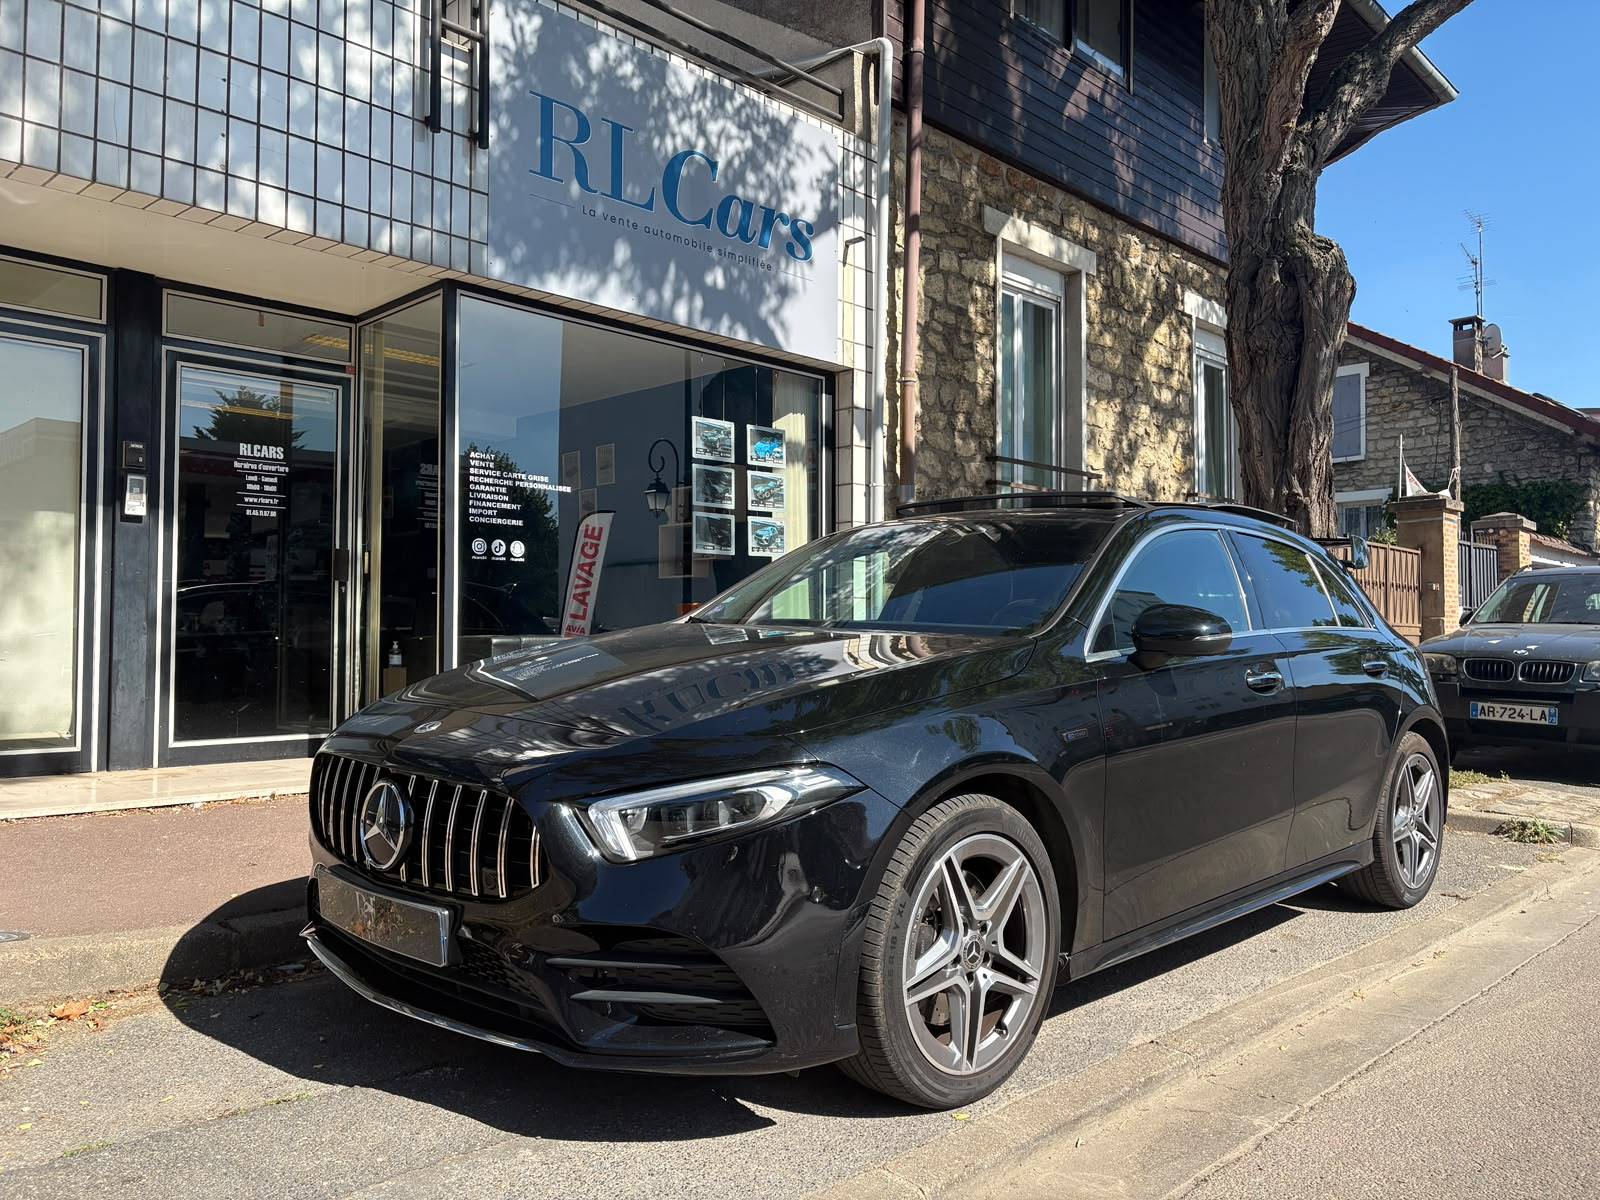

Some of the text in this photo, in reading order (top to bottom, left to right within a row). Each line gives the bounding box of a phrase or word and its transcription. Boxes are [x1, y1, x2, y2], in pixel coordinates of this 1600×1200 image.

[529, 90, 816, 262] RLCars
[582, 205, 772, 271] La vente automobile simplifiée
[239, 442, 284, 460] RLCARS
[469, 451, 495, 460] ACHAT
[469, 459, 495, 468] VENTE
[469, 467, 549, 483] SERVICE CARTE GRISE
[469, 475, 514, 486] RECHERCHE
[469, 483, 507, 493] GARANTIE
[469, 491, 509, 502] LIVRAISON
[469, 499, 522, 511] FINANCEMENT
[468, 507, 498, 516] IMPORT
[469, 515, 524, 527] CONCIERGERIE
[569, 523, 604, 622] LAVAGE
[1479, 705, 1548, 722] AR-724-LA
